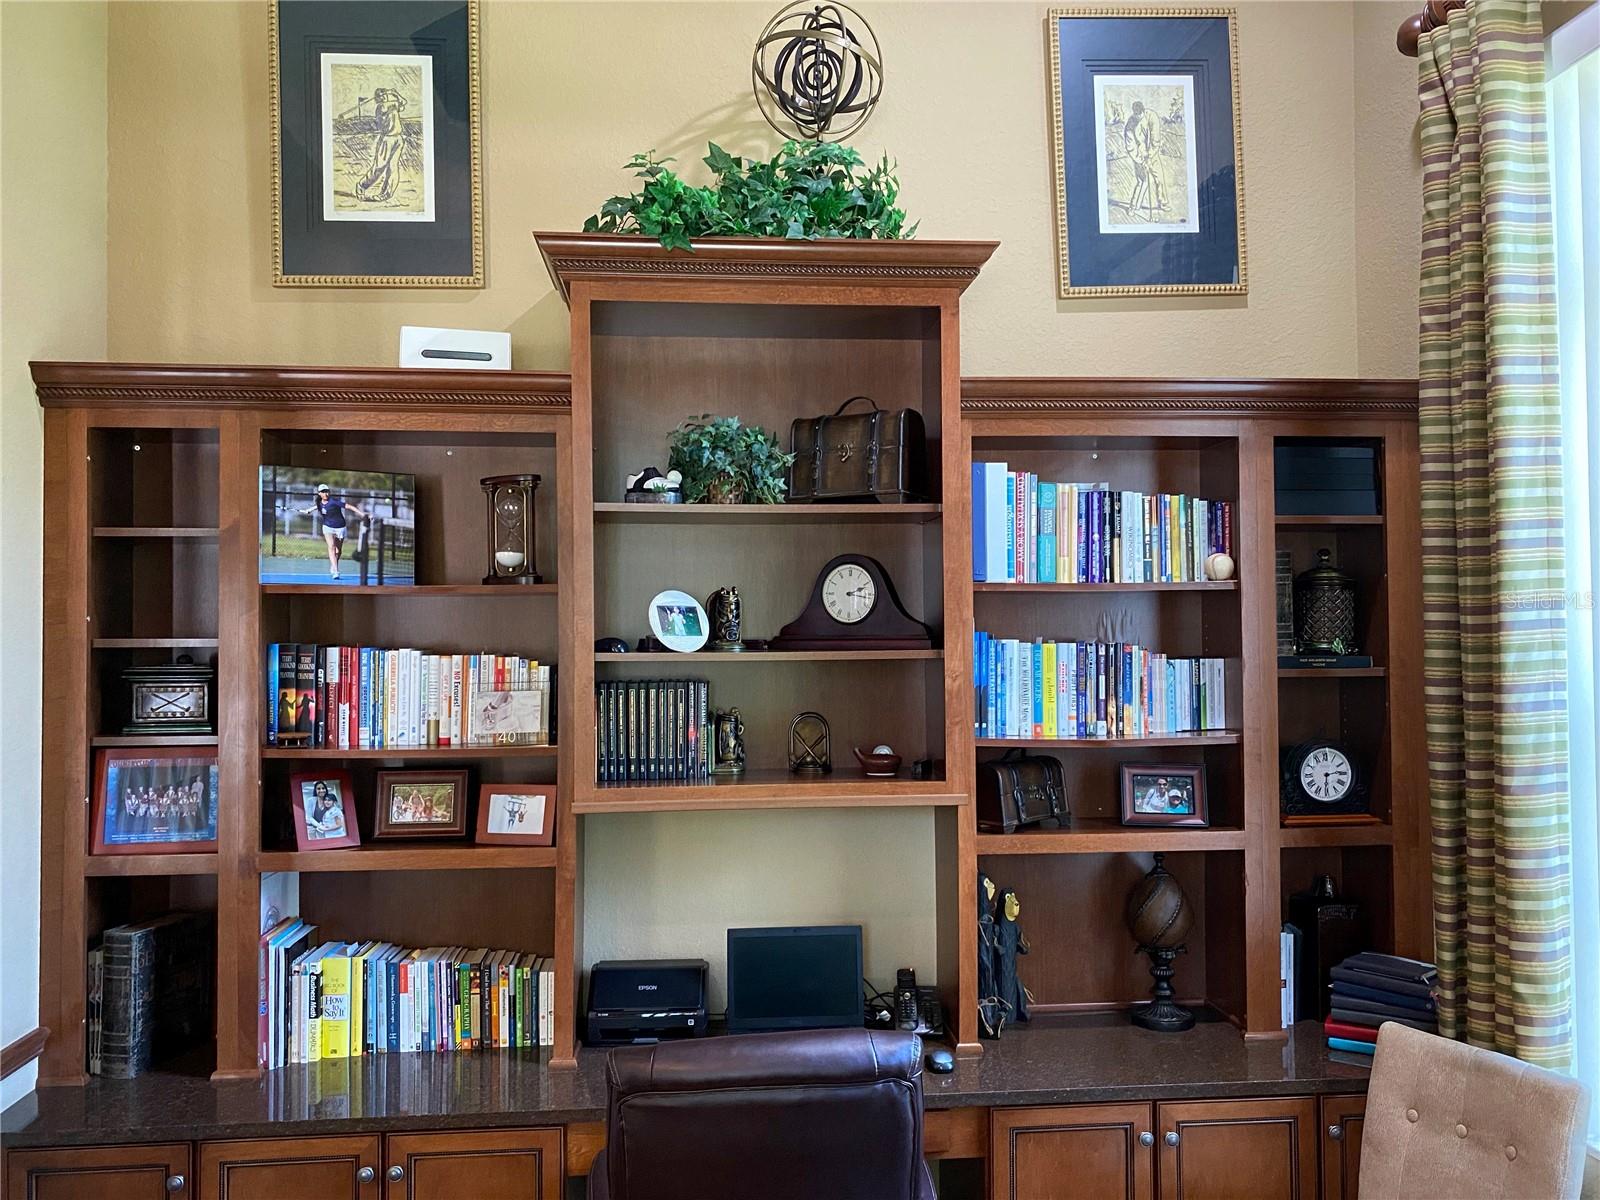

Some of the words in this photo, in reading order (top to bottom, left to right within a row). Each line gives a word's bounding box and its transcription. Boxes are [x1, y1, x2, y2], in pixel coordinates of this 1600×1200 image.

[454, 672, 460, 680] NO
[499, 730, 517, 743] 40
[326, 996, 344, 1005] How
[324, 1008, 338, 1019] Say
